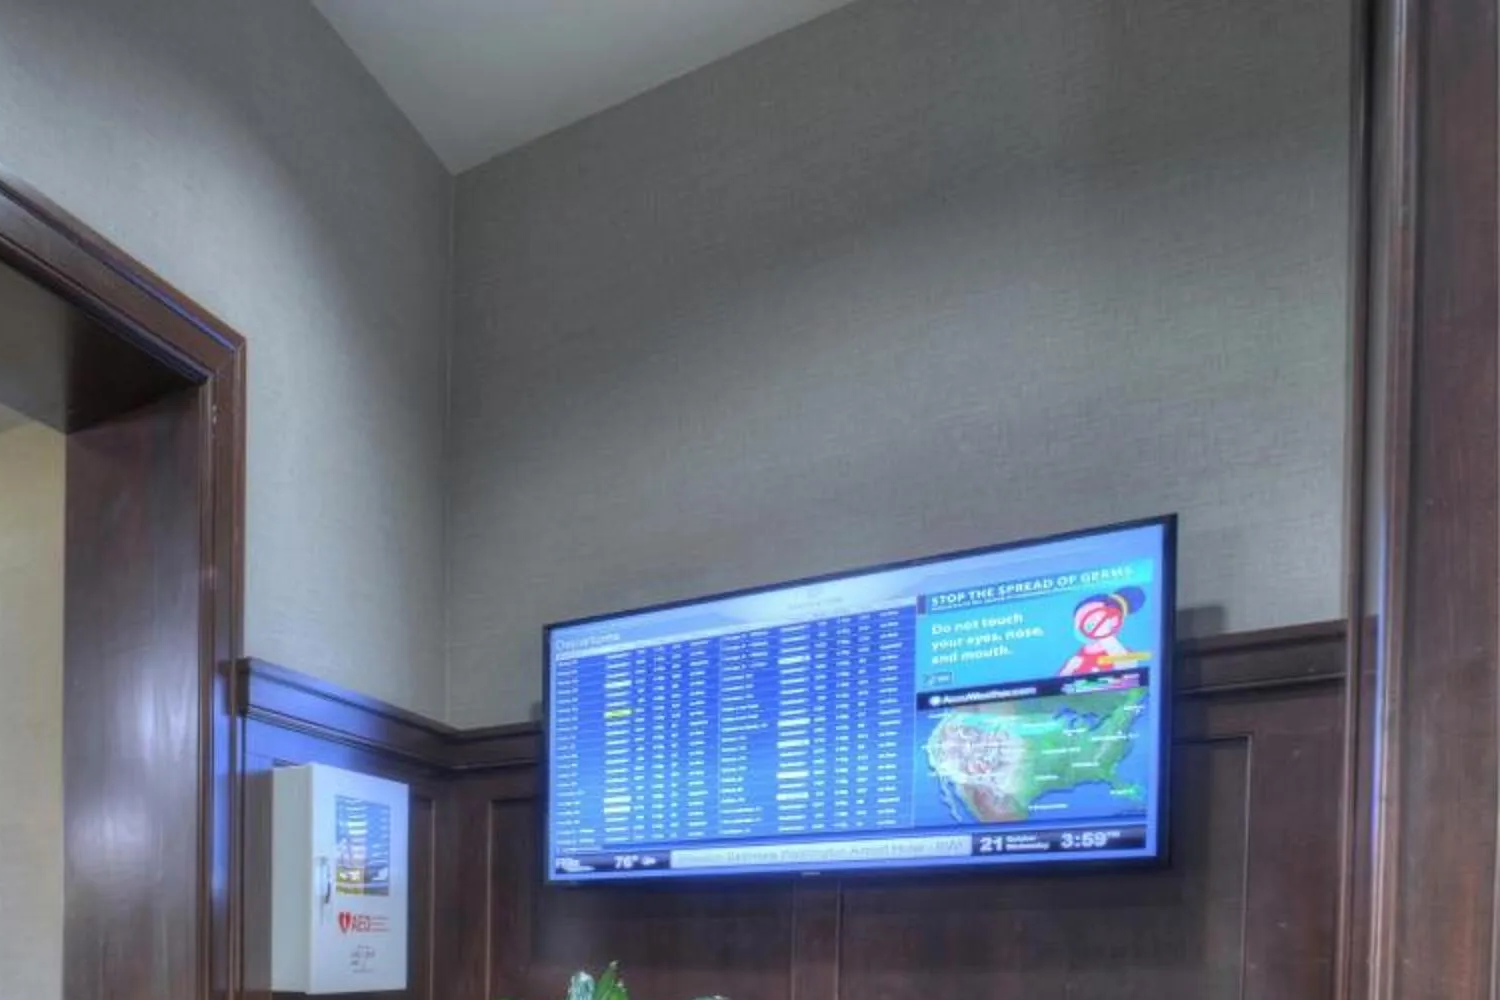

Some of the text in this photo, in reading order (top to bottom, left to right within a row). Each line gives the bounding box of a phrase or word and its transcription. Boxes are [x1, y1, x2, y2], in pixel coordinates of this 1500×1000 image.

[931, 565, 1135, 607] STOP THE SPREAD OF GERMS
[931, 612, 1023, 635] Do not touch
[931, 637, 963, 652] your
[931, 652, 957, 666] and
[979, 836, 1004, 852] 21
